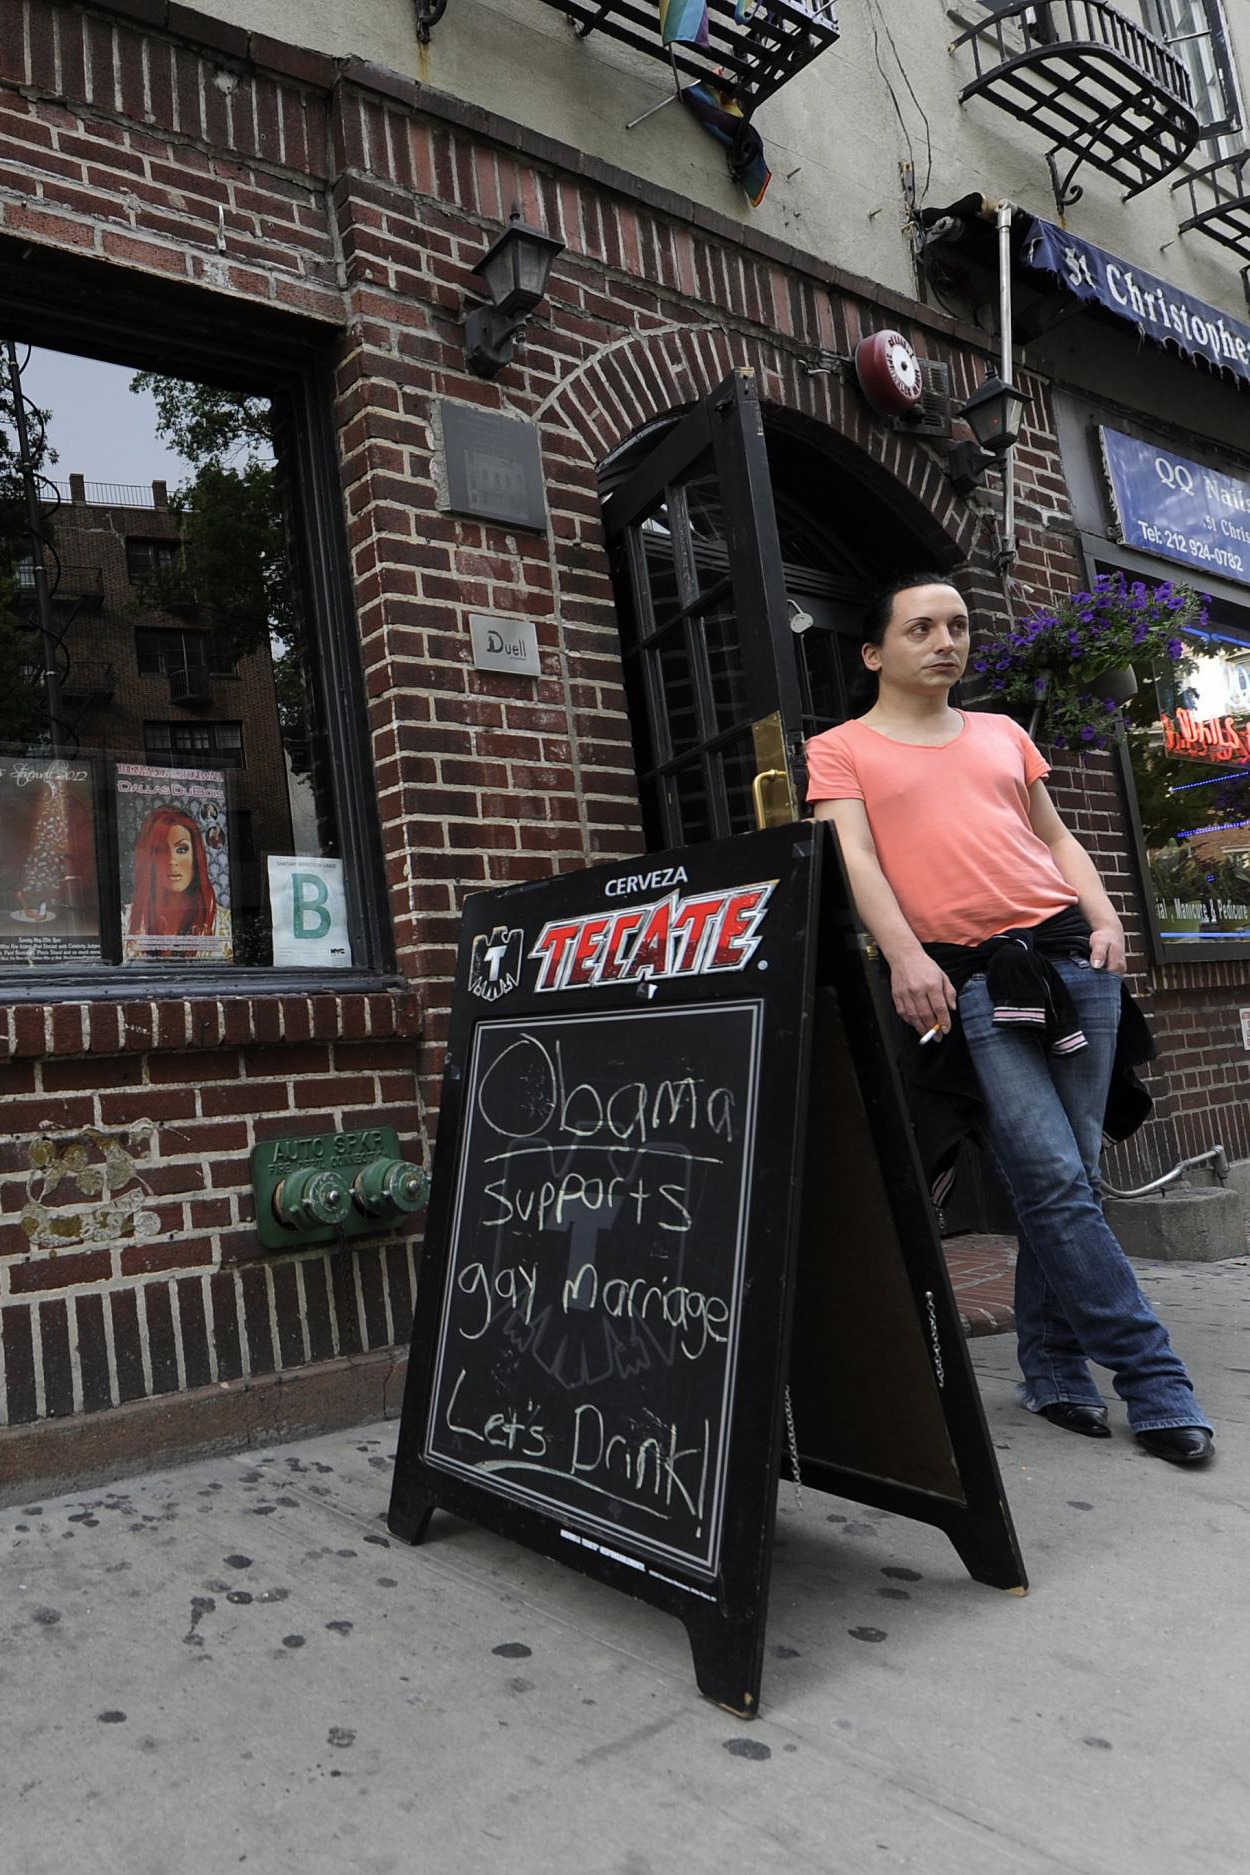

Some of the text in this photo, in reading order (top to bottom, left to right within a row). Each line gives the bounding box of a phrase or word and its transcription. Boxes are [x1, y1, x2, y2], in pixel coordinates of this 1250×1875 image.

[1106, 263, 1250, 366] Christophe
[1155, 457, 1195, 496] QQ
[1138, 520, 1244, 572] Tel: 212 924-0782
[487, 630, 527, 658] Duell
[291, 873, 332, 939] B
[605, 866, 688, 896] CERVEZA
[1217, 898, 1248, 920] Pedicure
[528, 879, 781, 993] TECATE
[479, 1033, 736, 1142] Obama
[268, 1162, 292, 1177] FIRE
[273, 1138, 324, 1162] AUTO
[458, 1262, 537, 1339] gay
[447, 1369, 546, 1456] Let's
